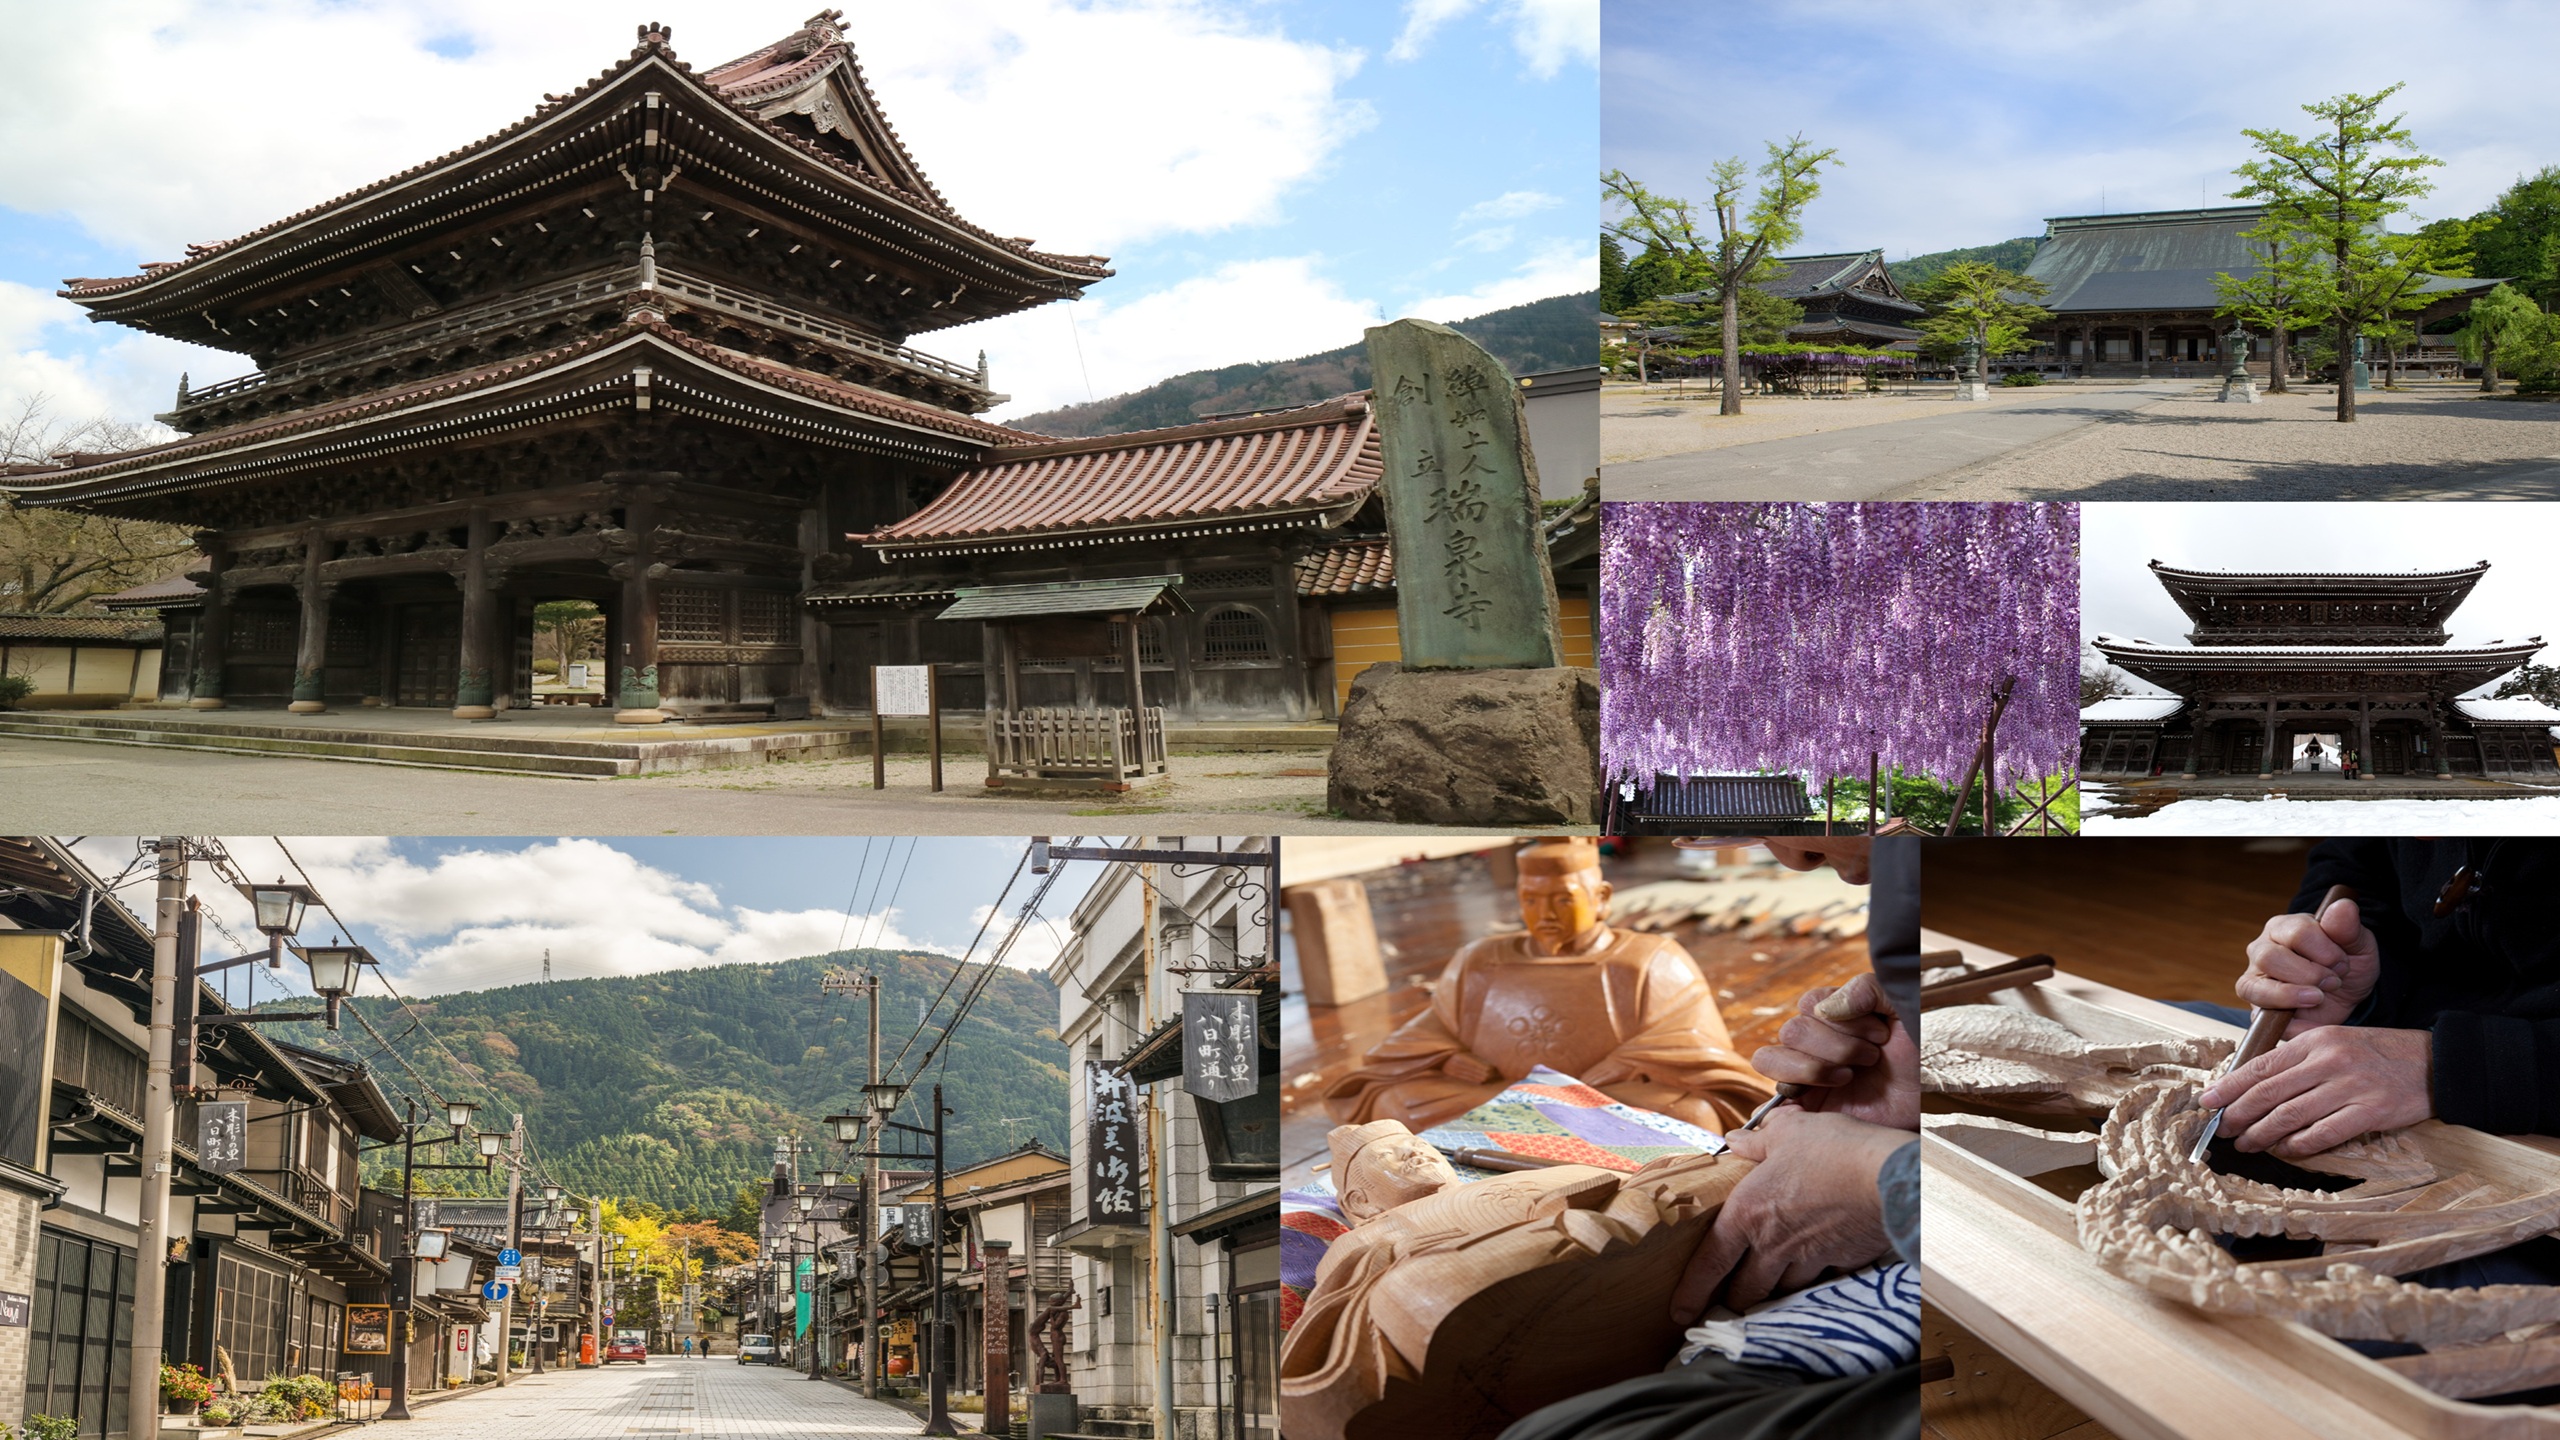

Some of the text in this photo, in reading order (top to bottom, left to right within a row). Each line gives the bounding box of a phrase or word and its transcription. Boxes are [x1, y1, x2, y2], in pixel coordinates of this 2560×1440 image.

[1196, 1014, 1228, 1091] 八日町通り
[1227, 1000, 1252, 1082] 木彫りの里
[206, 1118, 226, 1169] 八日町通り
[225, 1107, 241, 1162] 木彫りの里
[503, 1253, 516, 1262] 21
